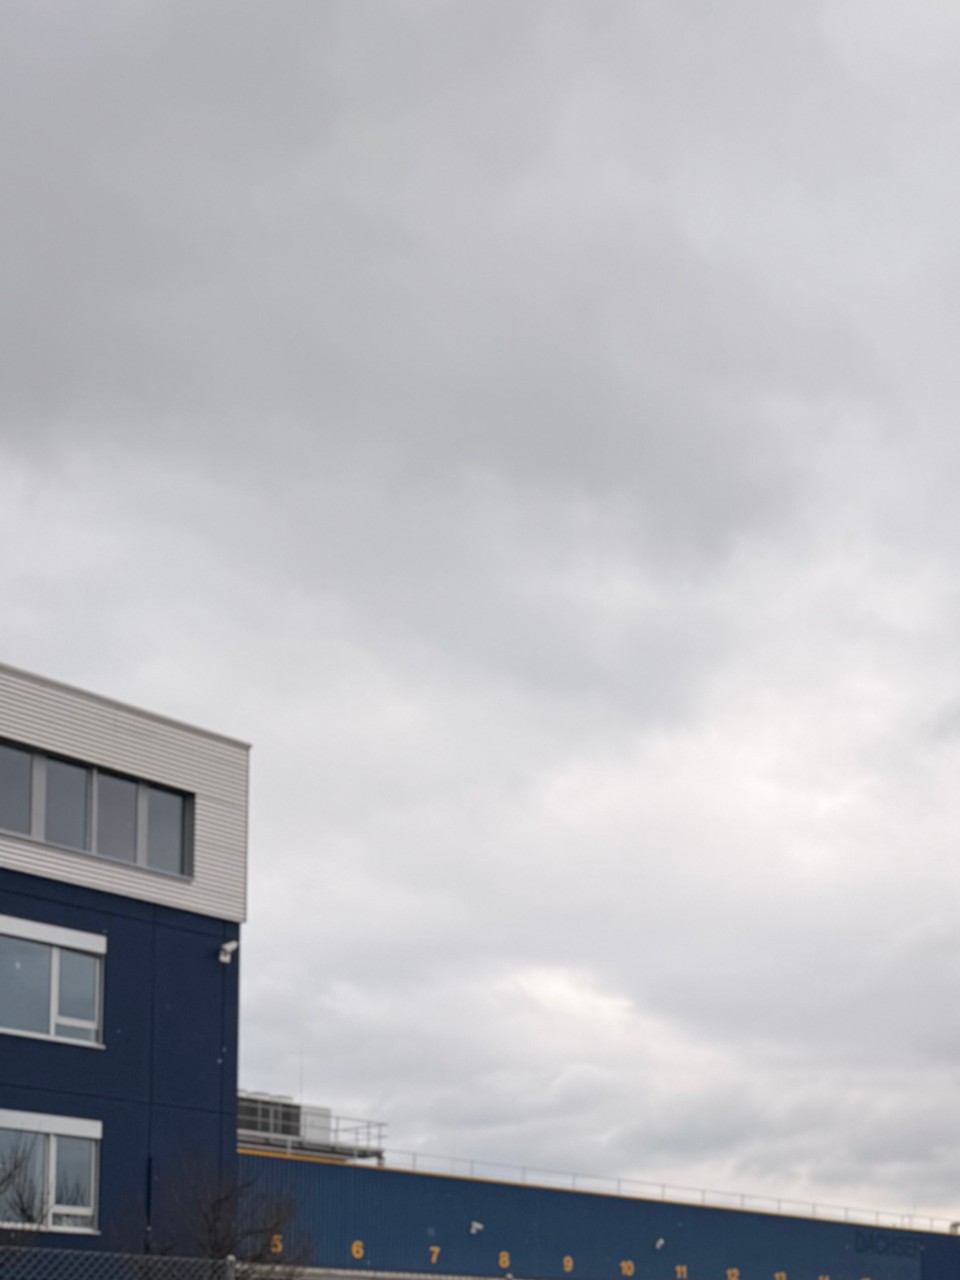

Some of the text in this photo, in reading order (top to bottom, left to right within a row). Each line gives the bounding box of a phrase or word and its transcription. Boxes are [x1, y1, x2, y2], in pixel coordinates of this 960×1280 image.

[271, 1234, 283, 1253] 5
[351, 1240, 364, 1259] 6
[429, 1246, 441, 1264] 7
[498, 1251, 510, 1269] 8
[562, 1255, 574, 1273] 9
[619, 1259, 635, 1277] 10
[675, 1264, 688, 1280] 11
